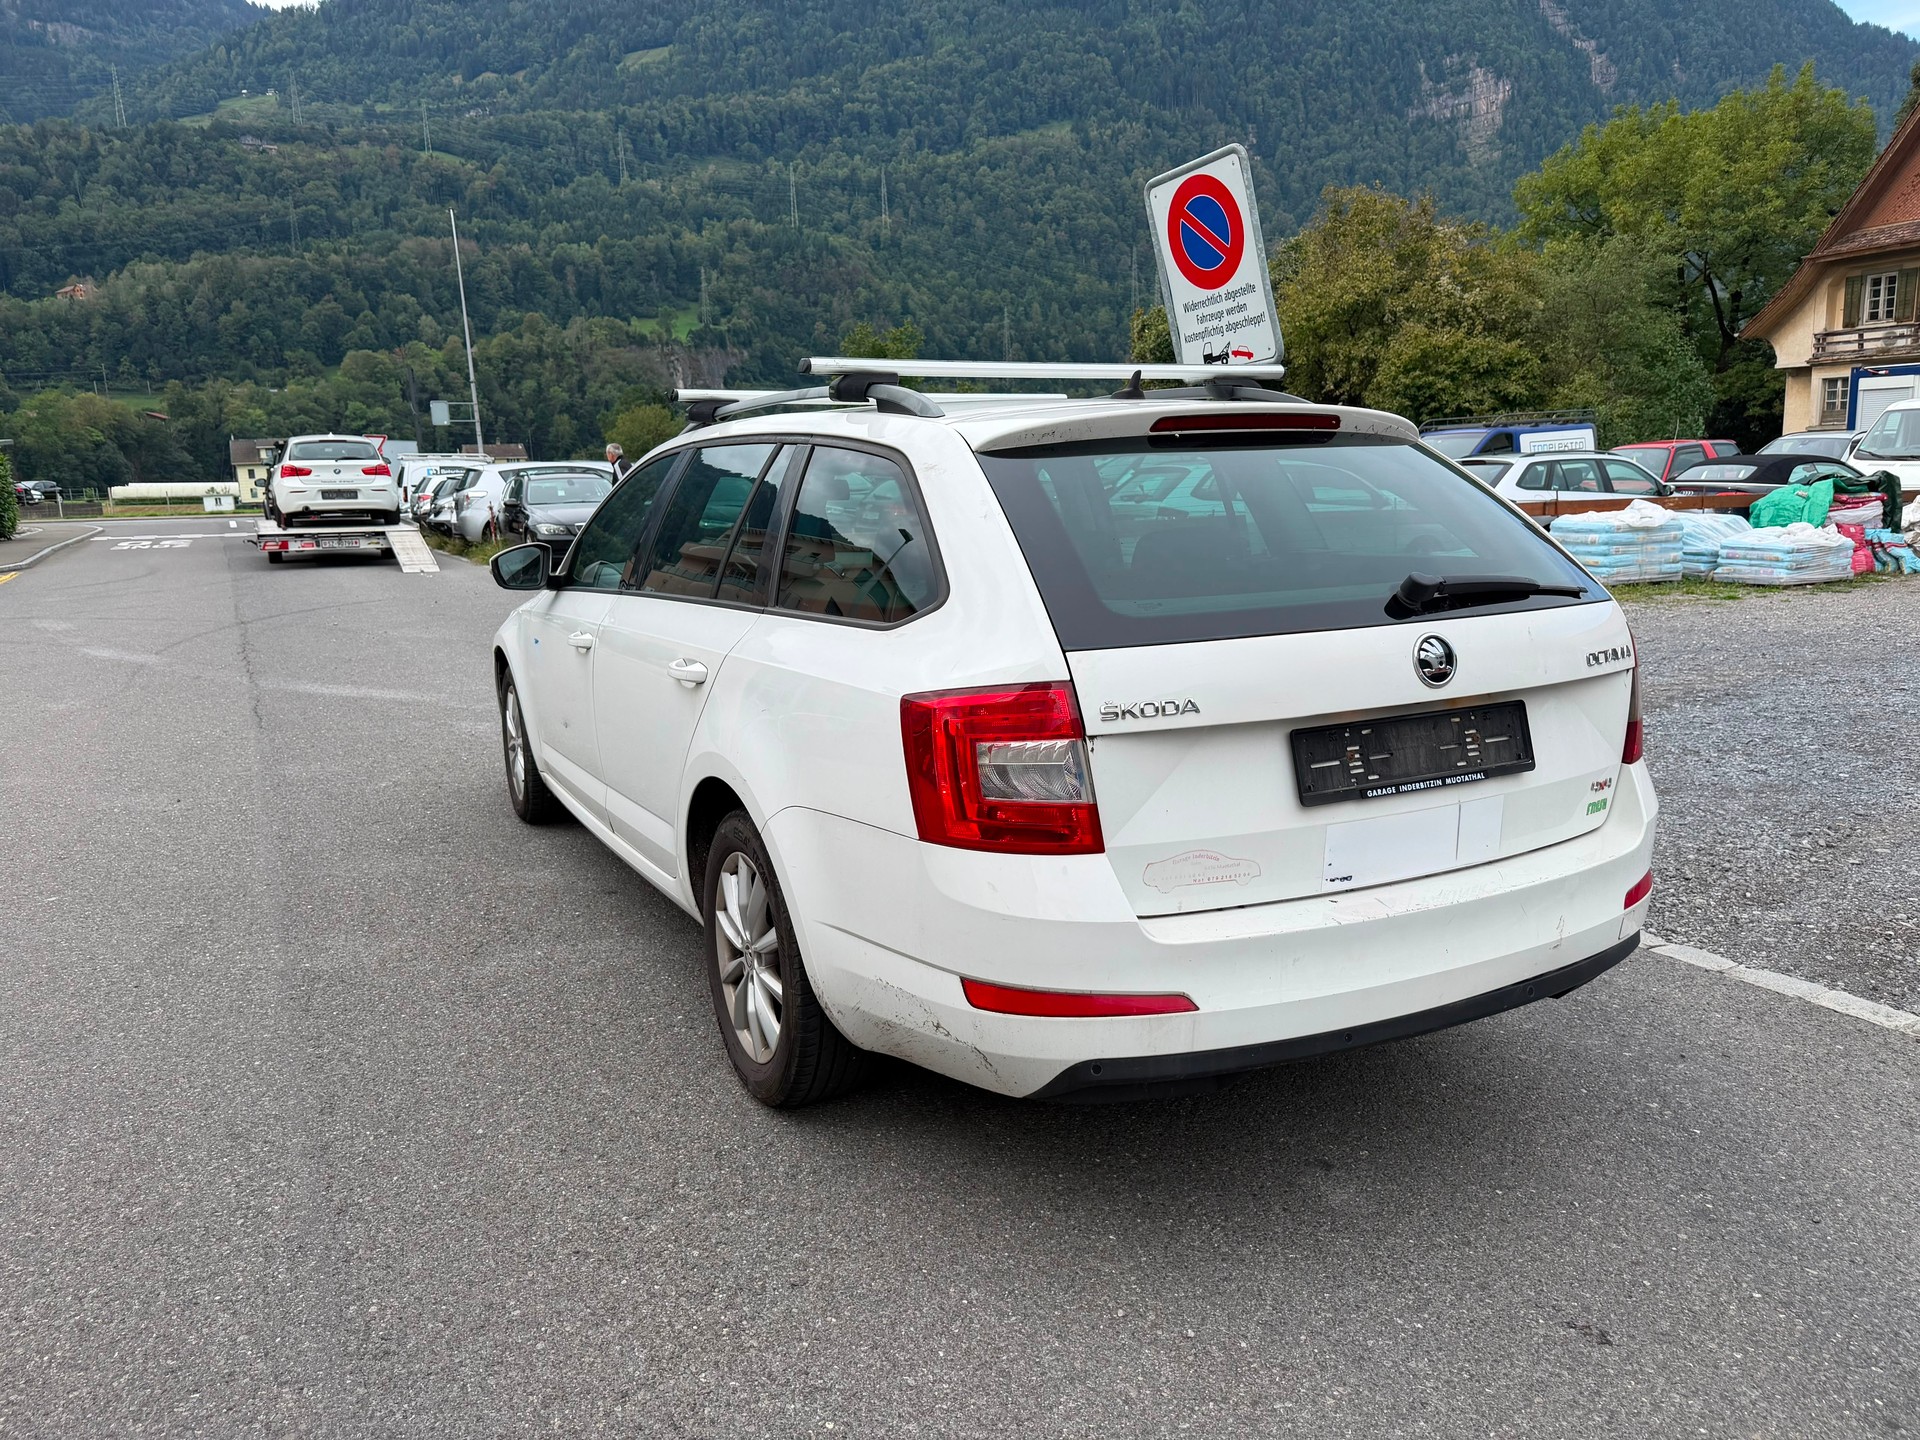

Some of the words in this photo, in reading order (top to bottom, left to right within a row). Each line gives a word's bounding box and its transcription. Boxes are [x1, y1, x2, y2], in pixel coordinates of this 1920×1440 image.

[1182, 291, 1223, 314] Widerrechtlich
[1224, 282, 1256, 302] abgestellte
[1196, 309, 1225, 326] Fahrzeuge
[1225, 302, 1248, 317] werden
[1183, 324, 1225, 344] kostenpflichtig
[1225, 311, 1266, 334] abgeschleppt!
[1586, 645, 1631, 667] OCTAVIA
[1100, 697, 1200, 721] ŠKODA
[1367, 786, 1396, 797] GARAGE
[1399, 779, 1442, 792] INDERBITZIN
[1445, 772, 1485, 785] MUOTATHAL
